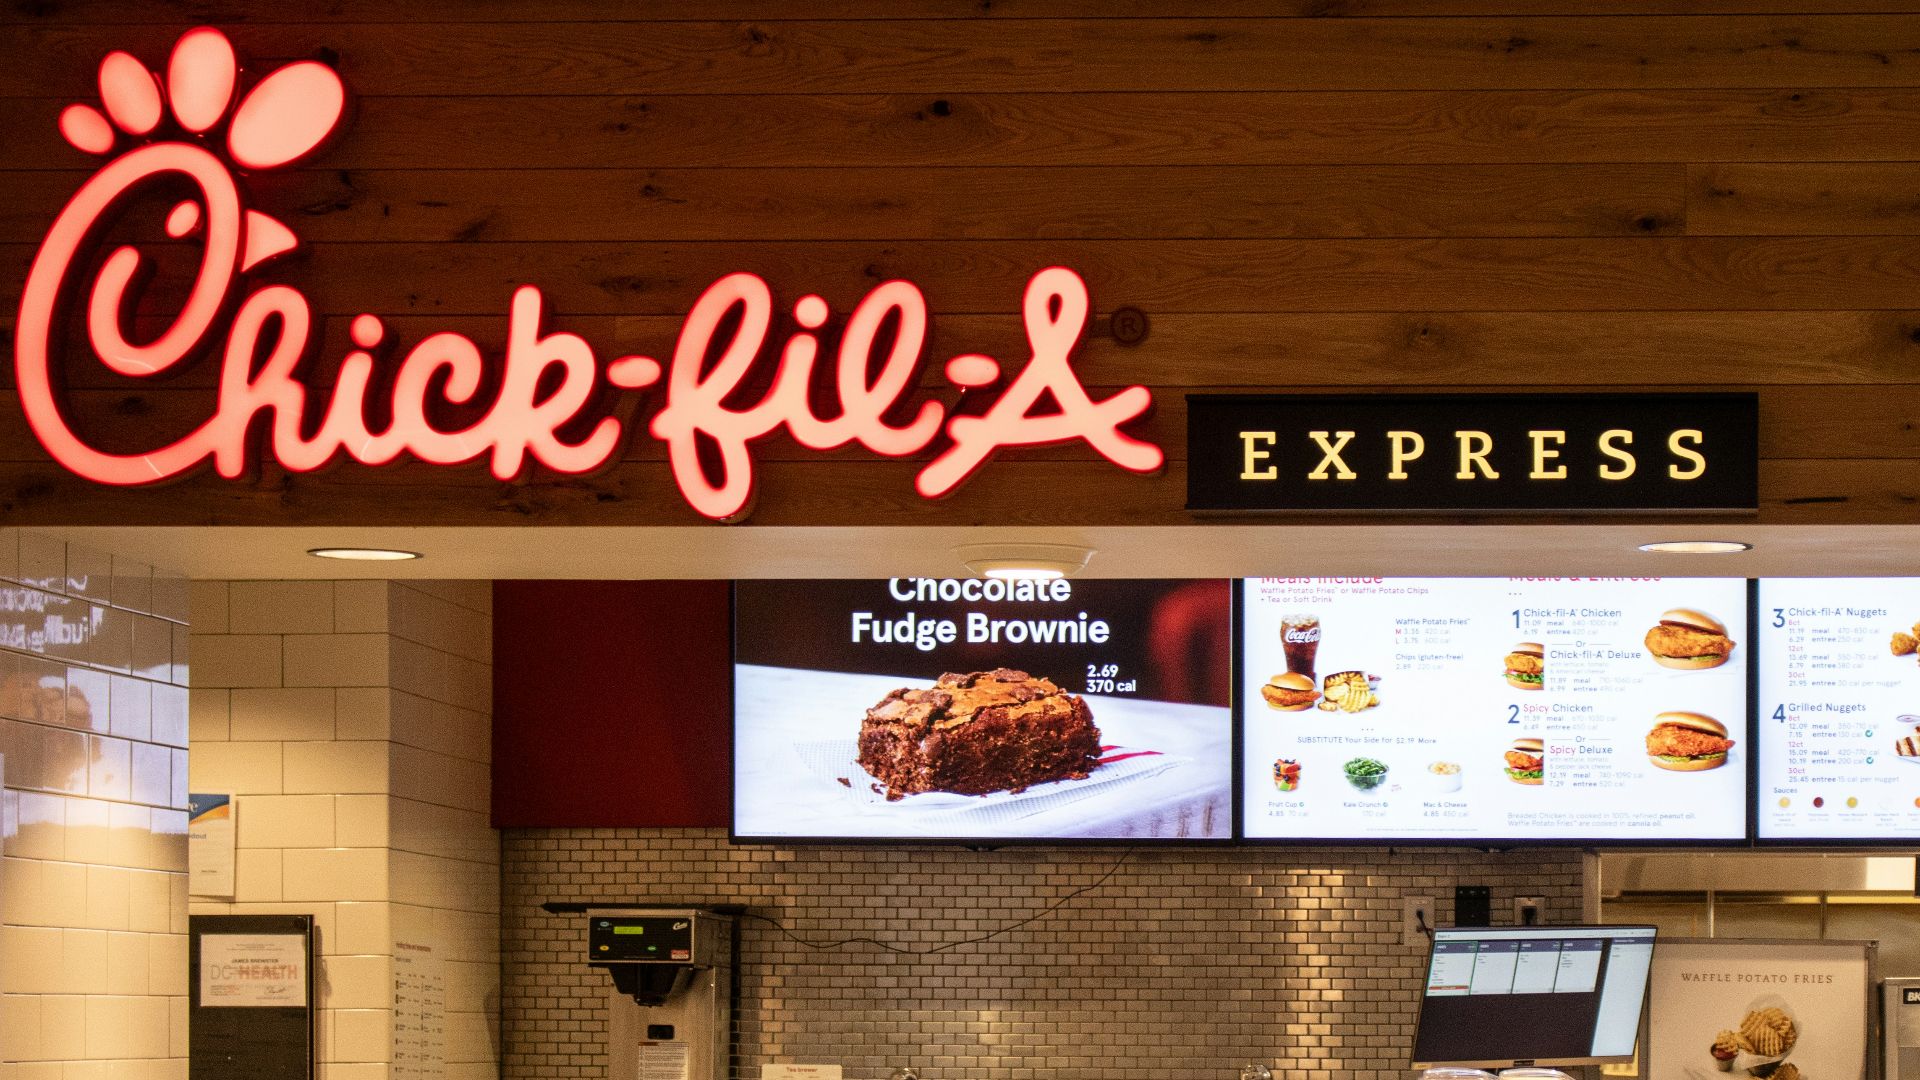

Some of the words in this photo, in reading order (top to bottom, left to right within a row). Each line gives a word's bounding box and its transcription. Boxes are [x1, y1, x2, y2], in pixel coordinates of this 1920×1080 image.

[14, 141, 1165, 519] Chick-fil-A
[1240, 429, 1707, 480] EXPRESS
[889, 578, 1071, 602] Chocolate
[1407, 587, 1429, 596] Chips
[1580, 608, 1622, 618] Chicken
[1772, 608, 1786, 628] 3
[1846, 607, 1887, 619] Nuggets
[1512, 609, 1521, 629] 1
[852, 613, 957, 651] Fudge
[967, 613, 1110, 644] Brownie
[1576, 640, 1586, 648] Or
[1395, 653, 1416, 661] Chips
[1608, 650, 1642, 659] Deluxe
[1087, 665, 1118, 678] 2.69
[1086, 679, 1114, 693] 370
[1116, 679, 1137, 693] cal
[1507, 704, 1520, 724] 2
[1523, 703, 1549, 714] Spicy
[1552, 703, 1593, 713] Chicken
[1772, 703, 1786, 724] 4
[1788, 703, 1823, 712] Grilled
[1825, 703, 1866, 714] Nuggets
[1297, 736, 1343, 744] SUBSTITUTE
[1345, 736, 1361, 744] Your
[1363, 736, 1380, 744] Side
[1381, 736, 1392, 744] for
[1575, 735, 1586, 743] Or
[1550, 745, 1576, 756] Spicy
[1579, 745, 1613, 754] Deluxe
[1874, 776, 1899, 785] nugget
[1285, 801, 1298, 809] Cup
[1659, 813, 1684, 821] peanut
[210, 964, 231, 980] DC
[238, 964, 297, 980] HEALTH
[1681, 972, 1731, 983] WAFFLE
[1737, 973, 1788, 984] POTATO
[1794, 974, 1833, 984] FRIES
